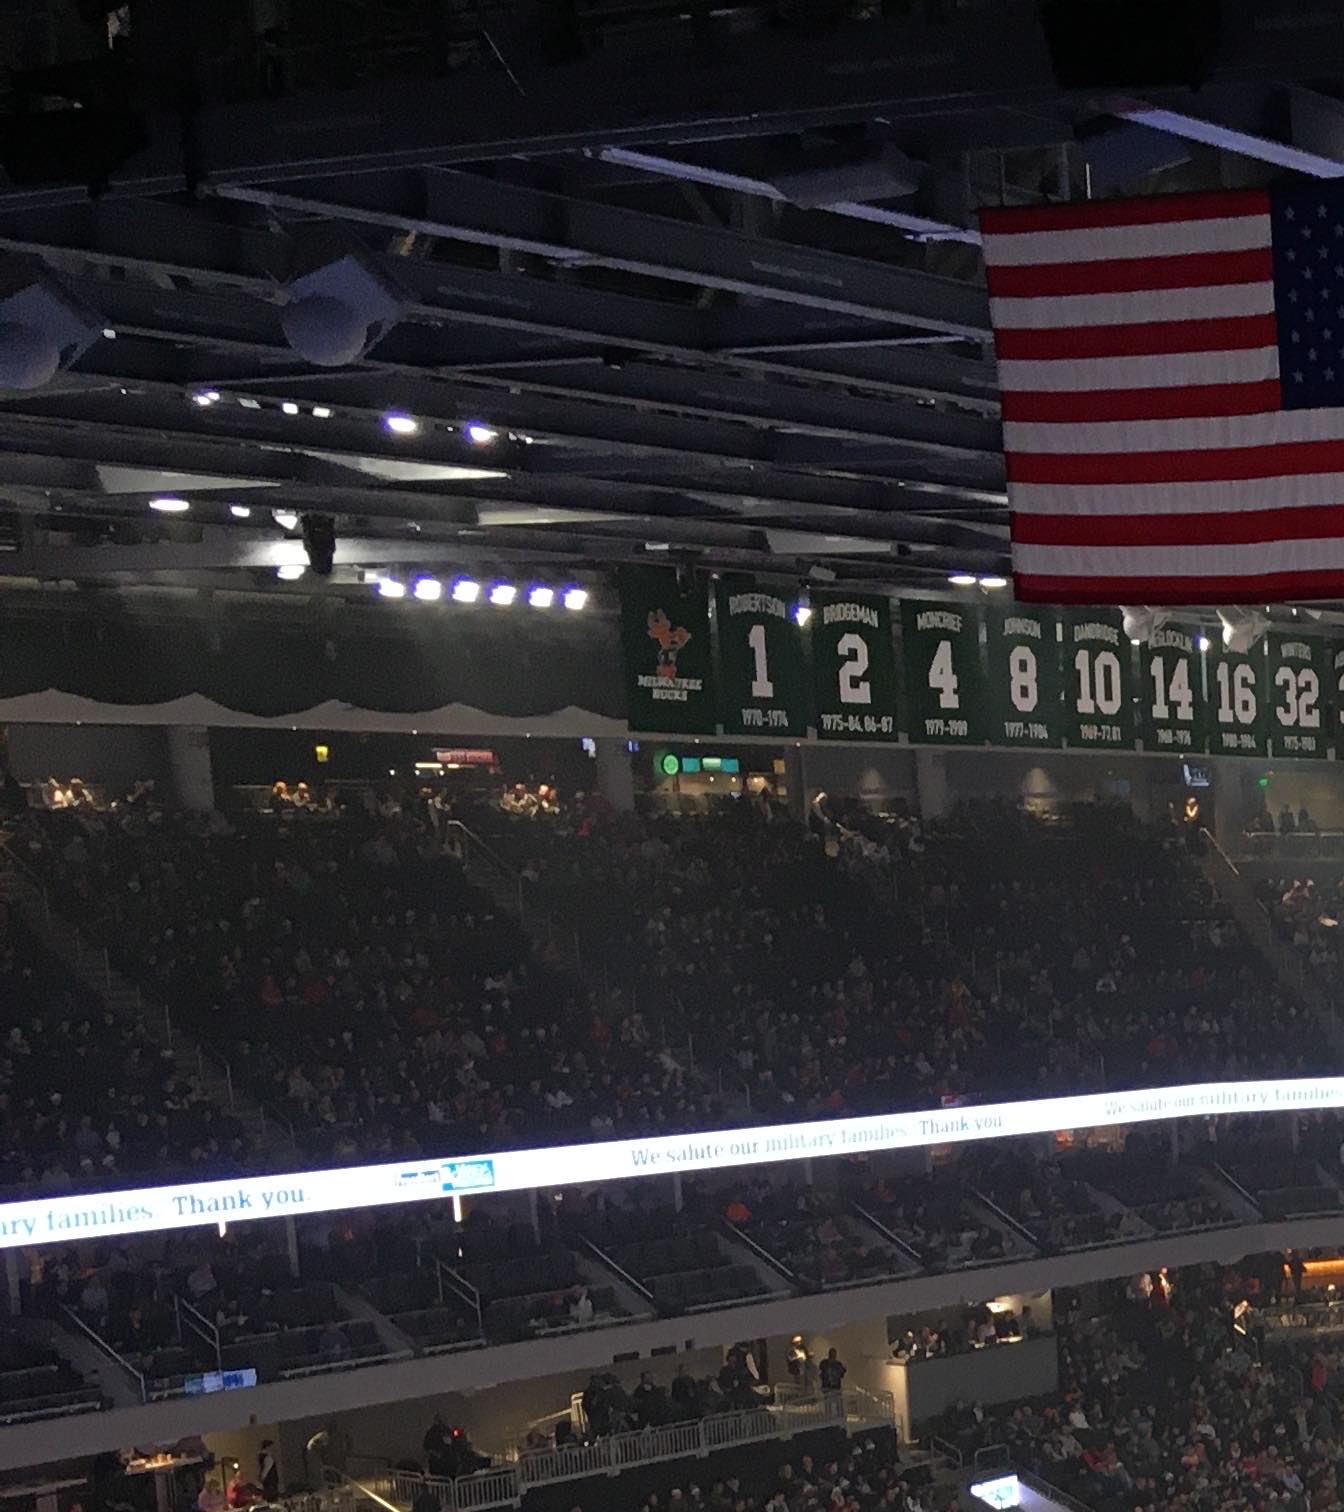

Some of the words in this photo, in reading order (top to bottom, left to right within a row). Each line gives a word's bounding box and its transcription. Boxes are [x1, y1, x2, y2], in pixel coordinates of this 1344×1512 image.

[823, 603, 879, 628] BRIDGEMAN
[917, 611, 963, 632] MONCRIEF
[1003, 617, 1041, 639] JOHNSON
[749, 625, 773, 697] 1
[838, 633, 871, 704] 2
[928, 640, 959, 709] 4
[1009, 645, 1038, 712] 8
[1075, 649, 1121, 715] 10
[1150, 656, 1193, 720] 14
[1216, 662, 1257, 724] 16
[1275, 666, 1320, 728] 32
[631, 1146, 660, 1167] We
[666, 1142, 725, 1163] salute
[730, 1138, 759, 1157] our
[765, 1126, 837, 1154] military
[919, 1115, 969, 1136] Thank
[172, 1191, 253, 1217] Thank
